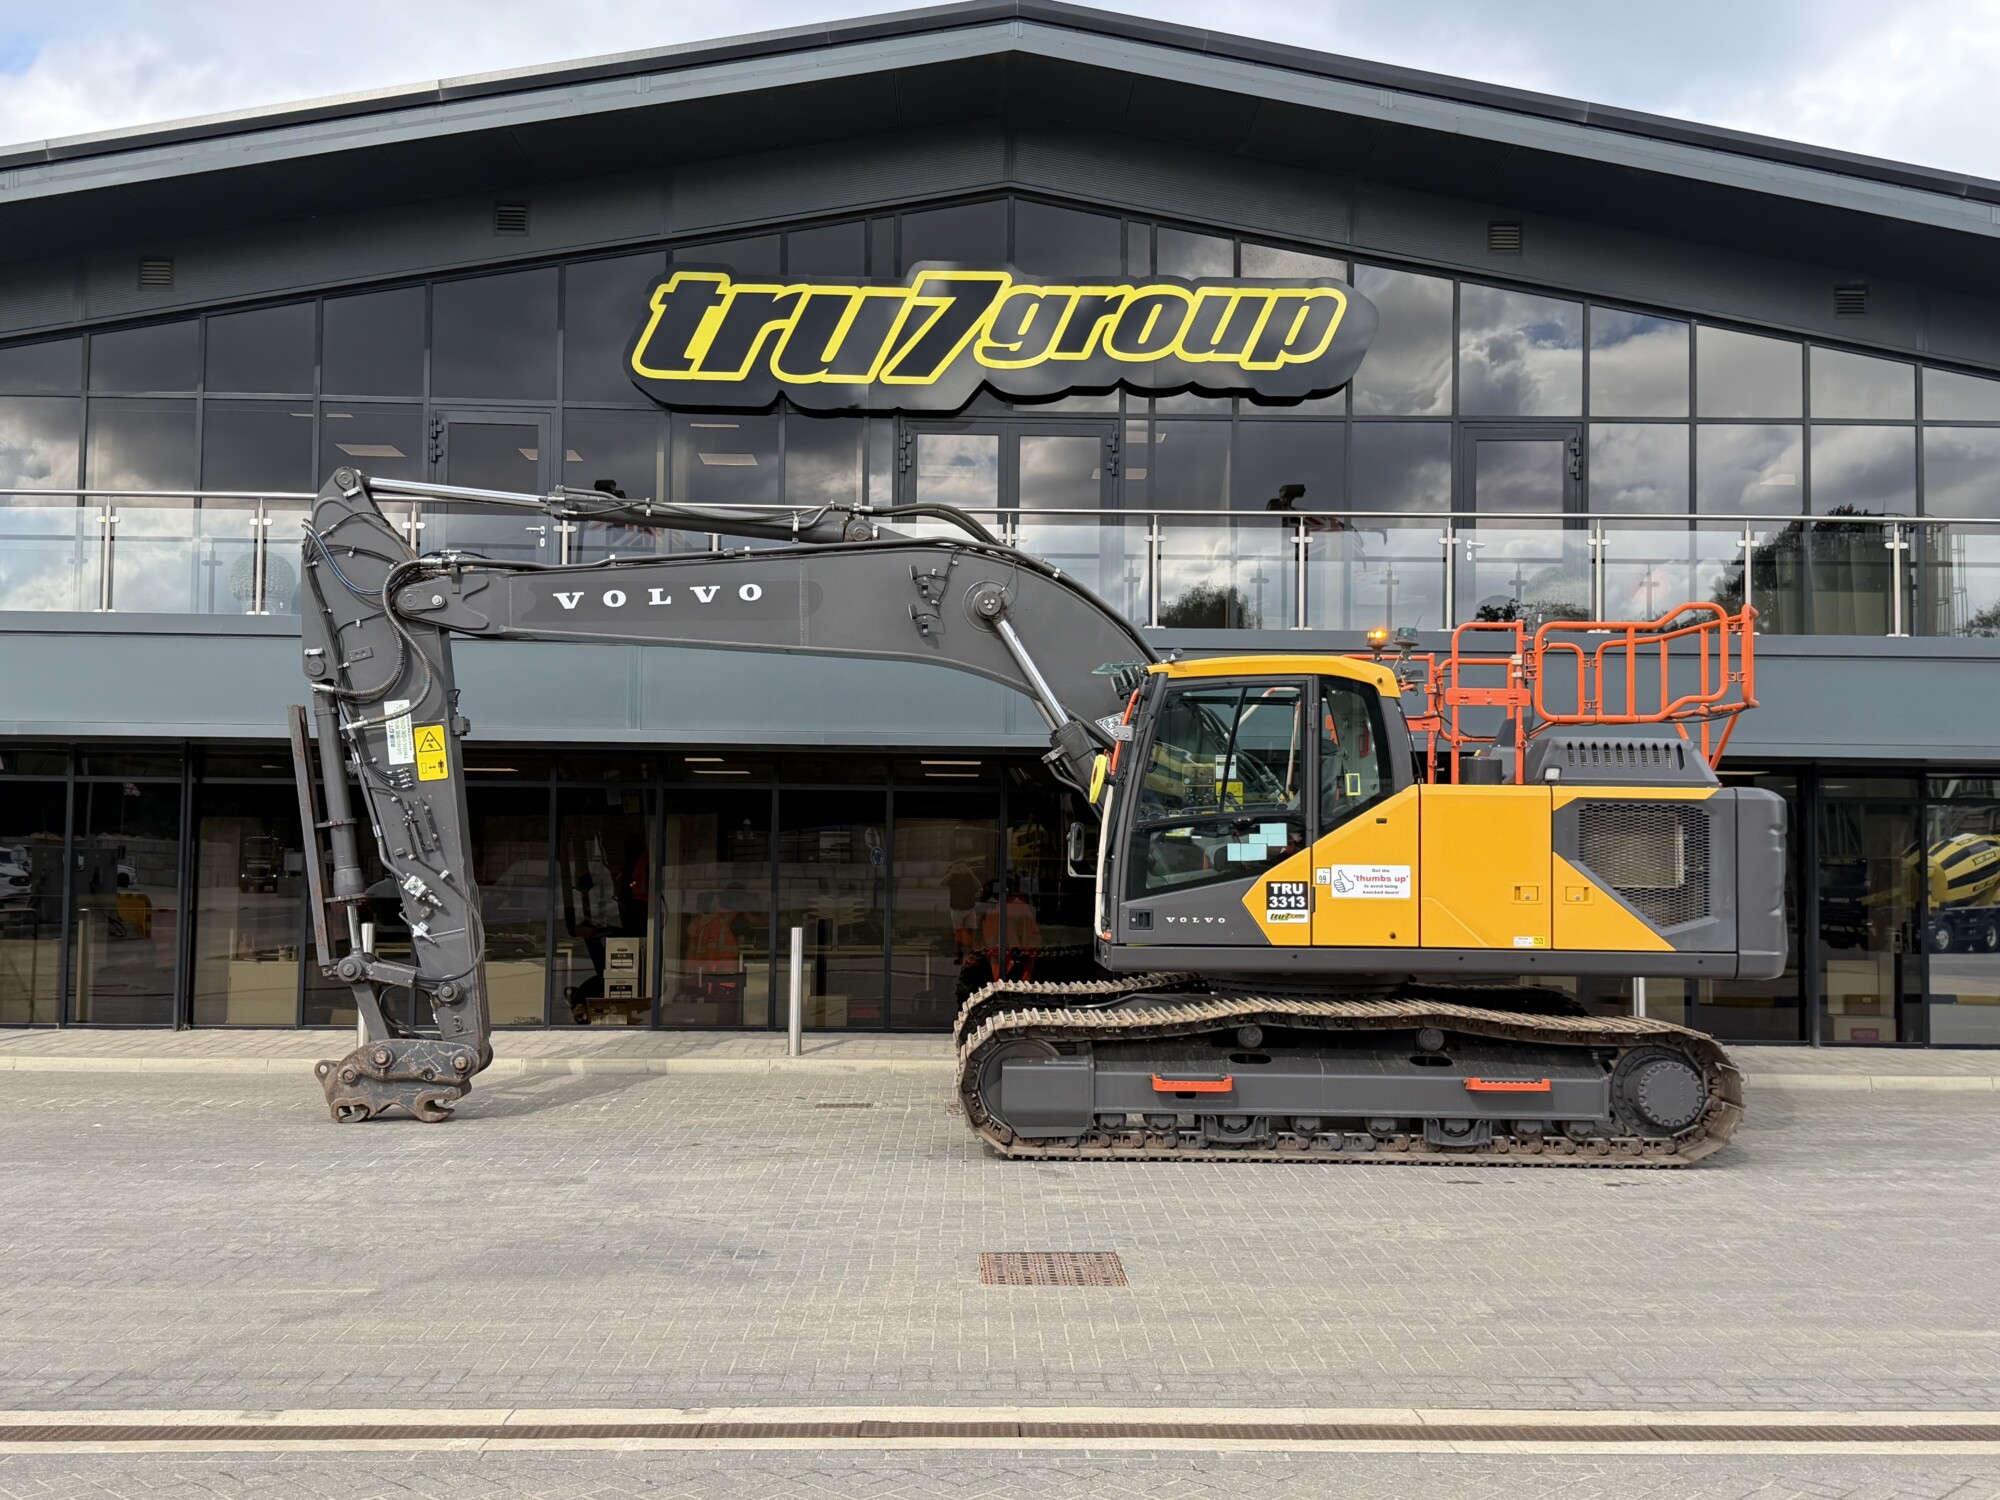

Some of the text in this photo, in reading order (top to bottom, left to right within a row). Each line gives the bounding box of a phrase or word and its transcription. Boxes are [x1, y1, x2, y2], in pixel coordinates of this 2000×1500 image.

[552, 583, 763, 610] VOLVO
[1270, 883, 1304, 895] TRU
[1269, 895, 1306, 908] 3313
[1165, 916, 1226, 924] VOLVO
